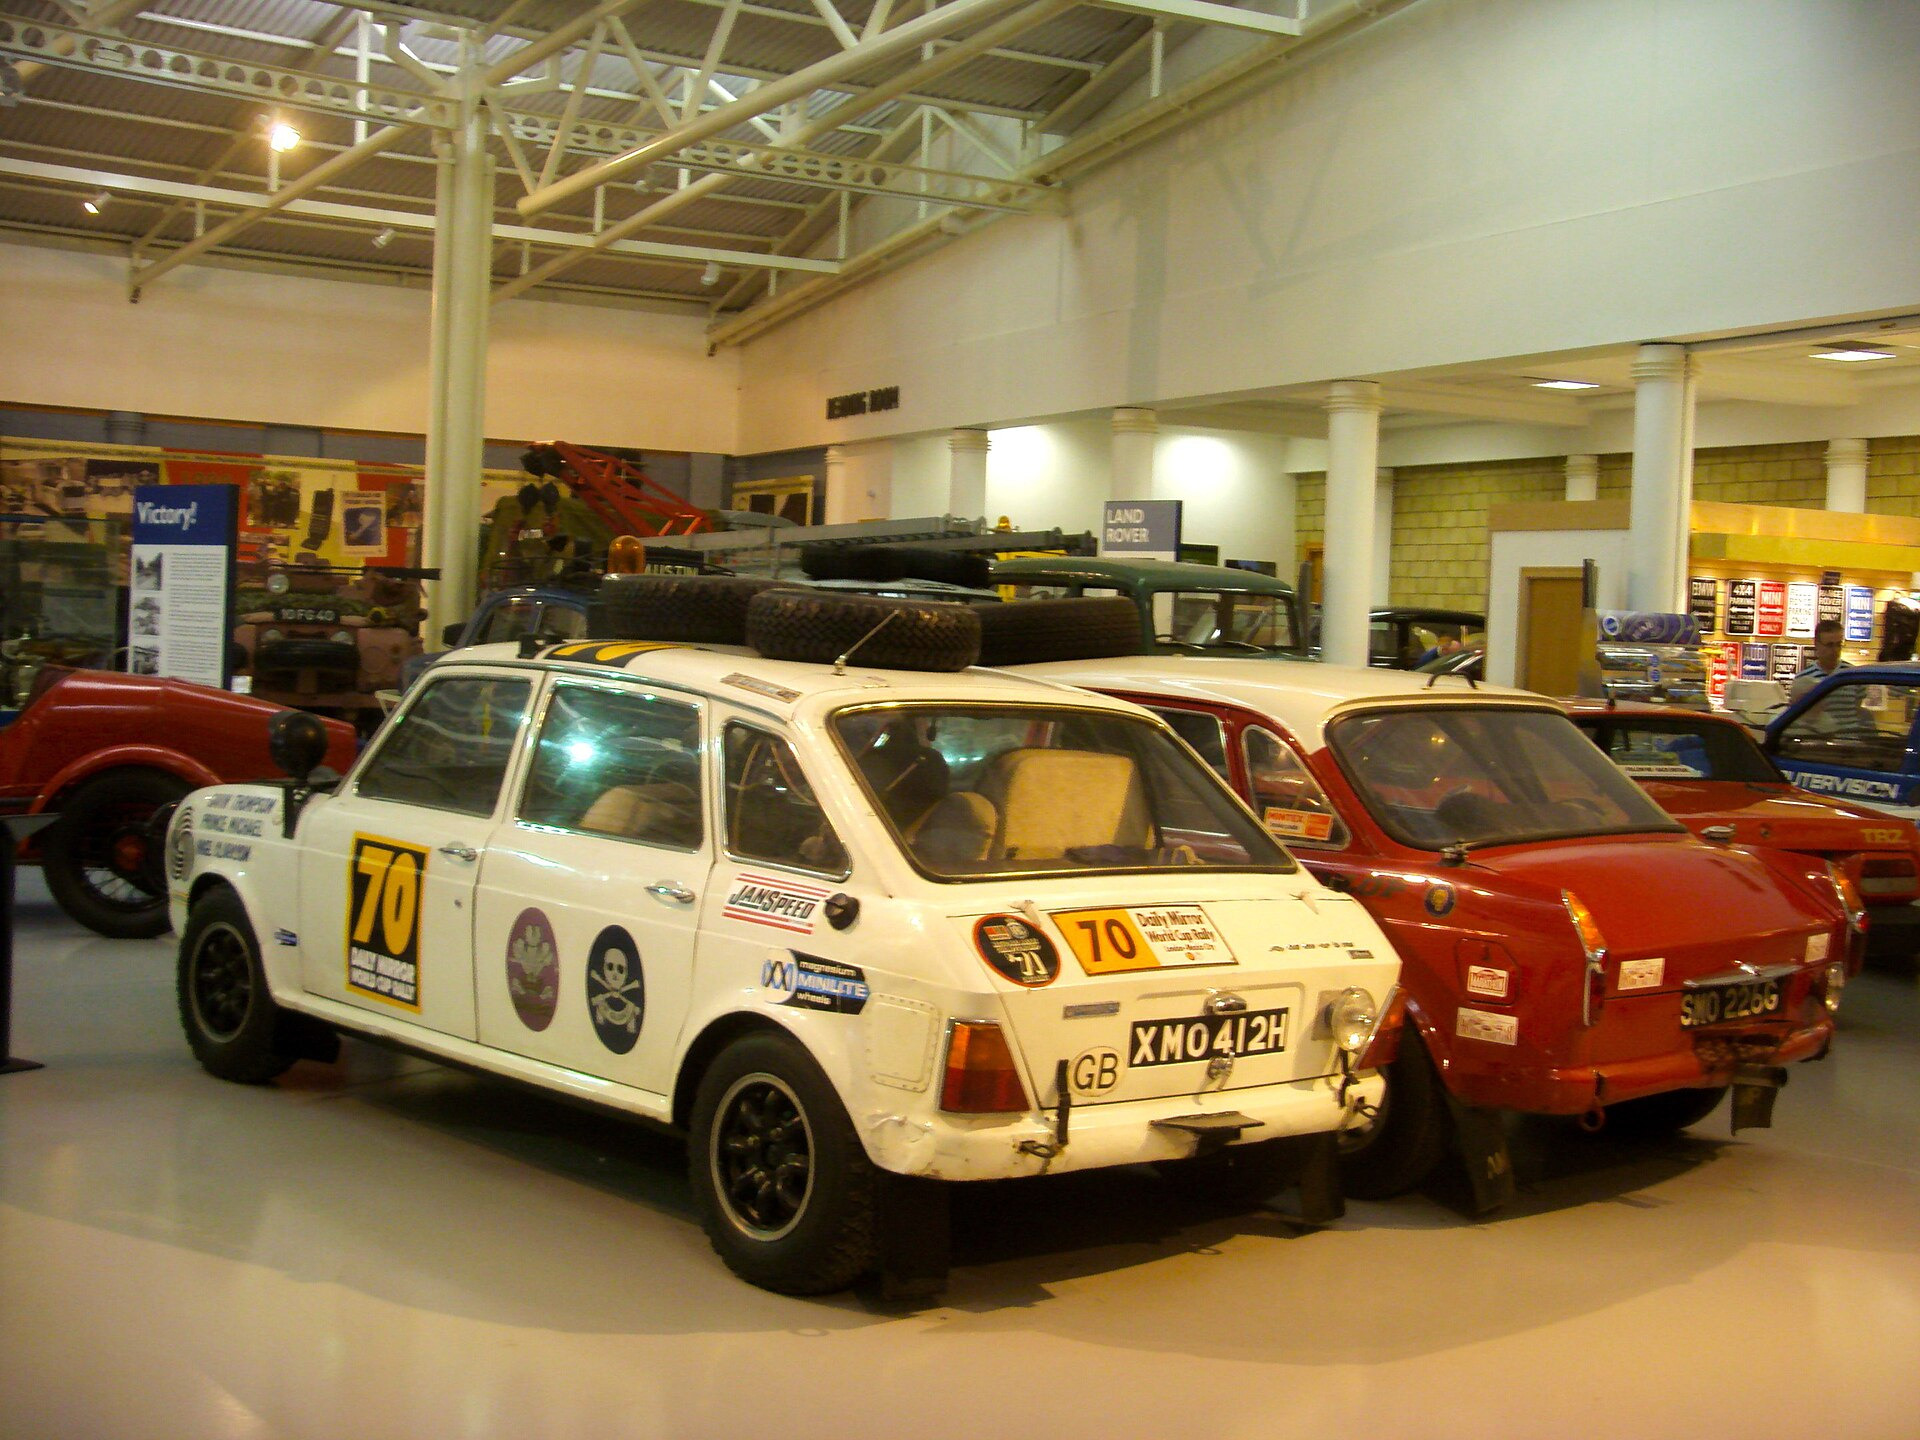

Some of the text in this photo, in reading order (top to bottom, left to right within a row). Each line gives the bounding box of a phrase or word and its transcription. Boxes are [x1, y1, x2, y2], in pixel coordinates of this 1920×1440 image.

[137, 501, 198, 531] Victory!
[1106, 508, 1145, 524] LAND
[1106, 528, 1150, 543] ROVER
[1692, 582, 1715, 596] BMW
[1761, 591, 1782, 605] MINI
[353, 844, 417, 955] 70
[728, 885, 818, 919] JANSPEED
[1136, 910, 1204, 929] Daily Mirror
[1076, 919, 1137, 963] 70
[1145, 928, 1215, 943] World Cup Rally
[799, 961, 858, 978] magnesium
[798, 973, 868, 997] MINILITE
[796, 991, 832, 1005] wheels
[1073, 1053, 1119, 1090] GB
